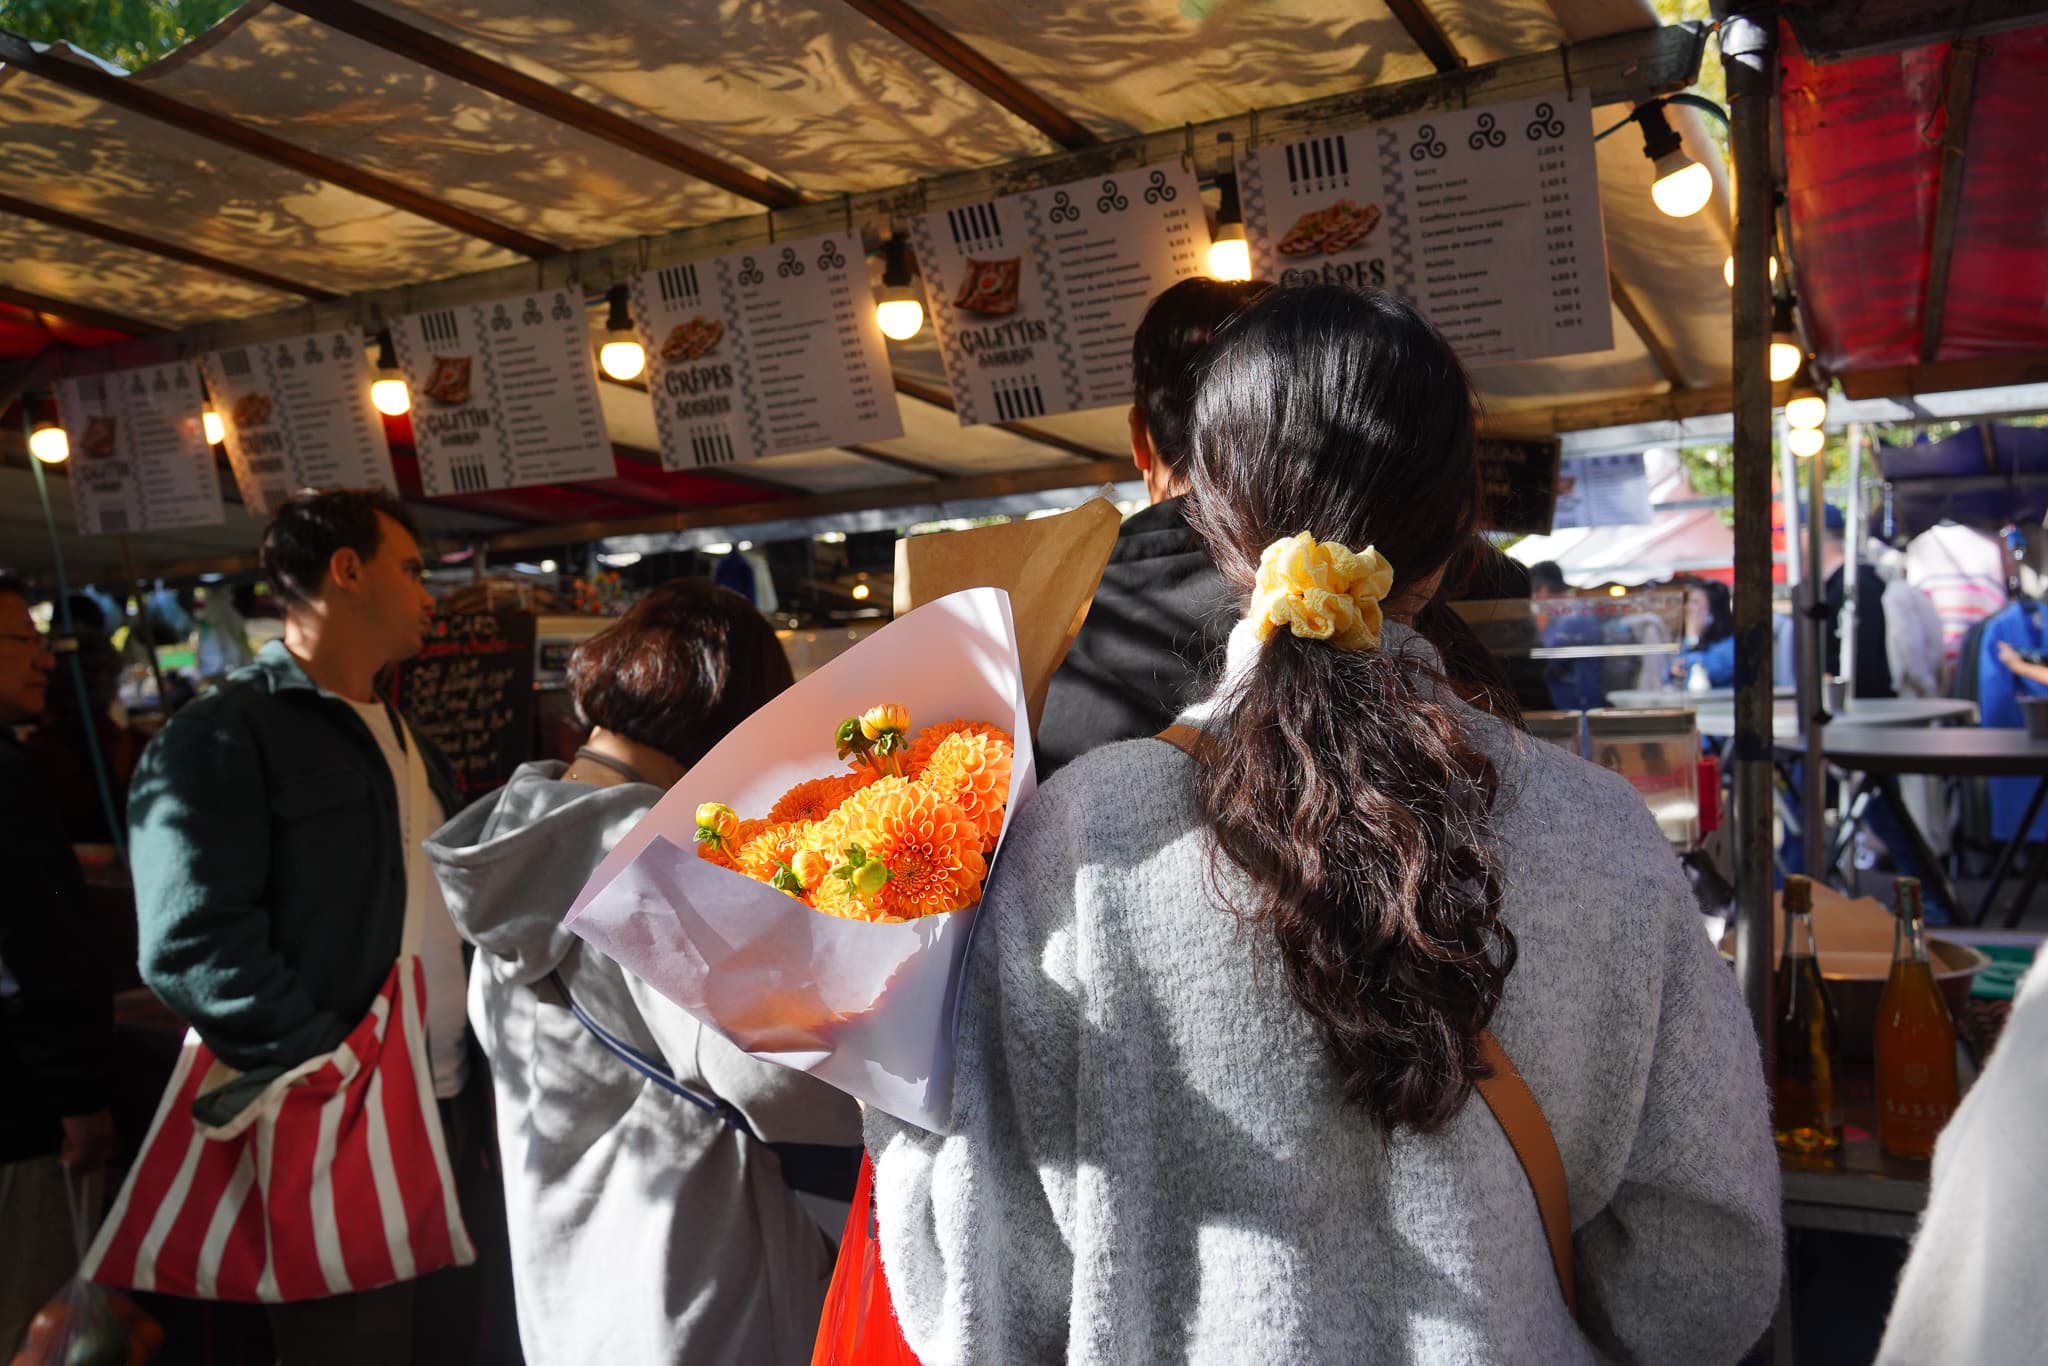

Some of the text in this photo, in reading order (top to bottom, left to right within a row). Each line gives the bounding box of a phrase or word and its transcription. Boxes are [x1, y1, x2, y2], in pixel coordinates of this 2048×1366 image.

[1425, 258, 1455, 269] Nutella
[1427, 273, 1457, 284] Nutella
[1429, 288, 1458, 299] Nutella
[1430, 304, 1461, 314] Nutella
